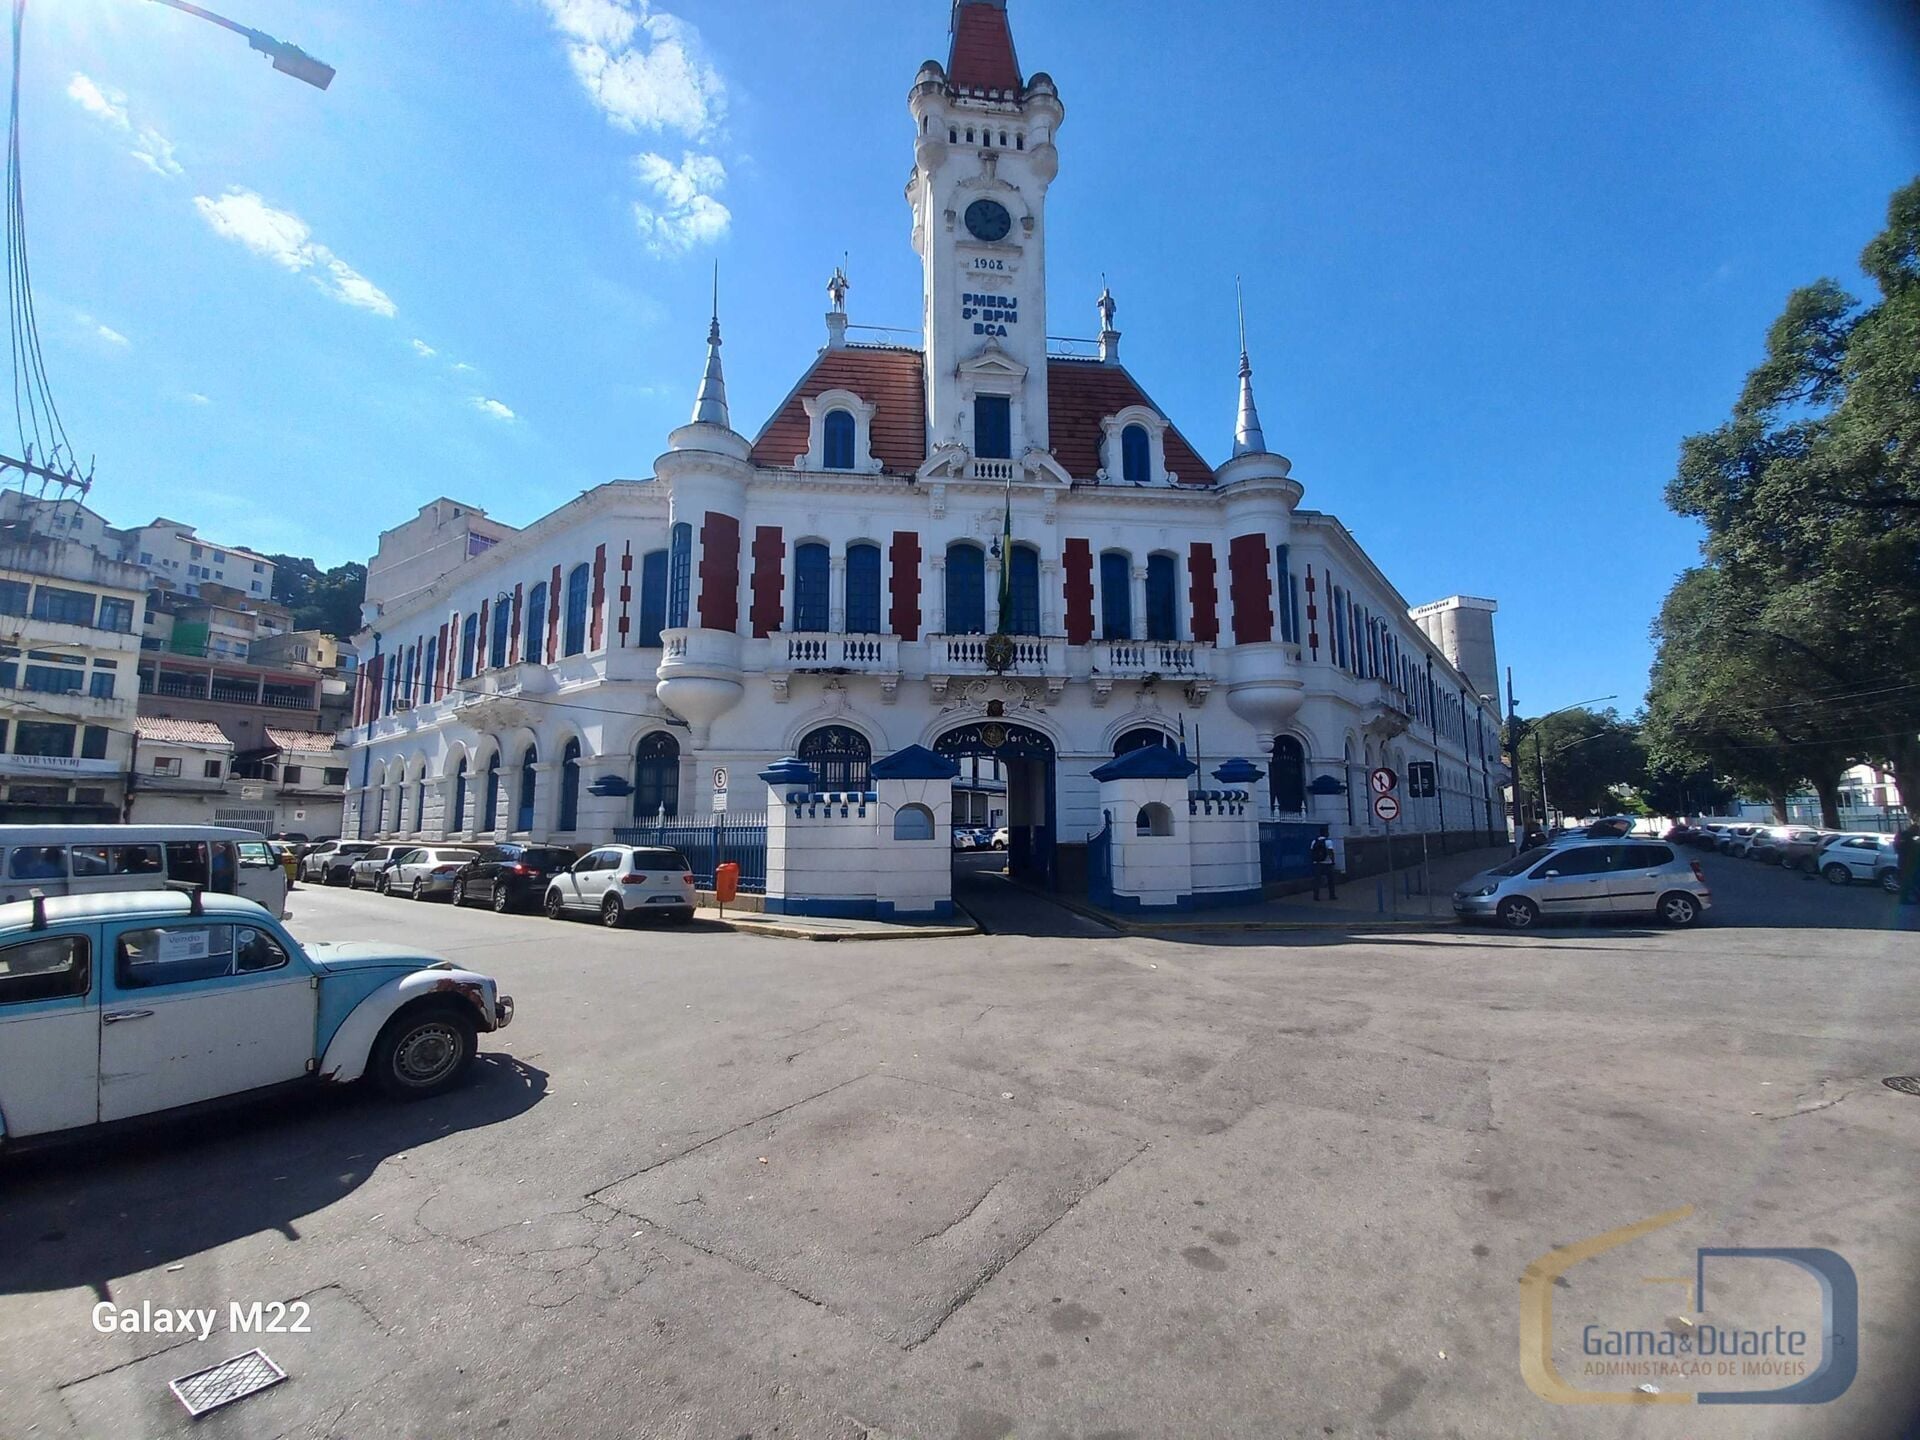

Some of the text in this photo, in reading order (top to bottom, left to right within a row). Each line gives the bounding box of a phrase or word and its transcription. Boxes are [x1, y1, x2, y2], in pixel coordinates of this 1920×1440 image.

[962, 293, 1017, 309] PMERJ
[982, 309, 1017, 323] BPM
[973, 322, 1008, 337] BCA
